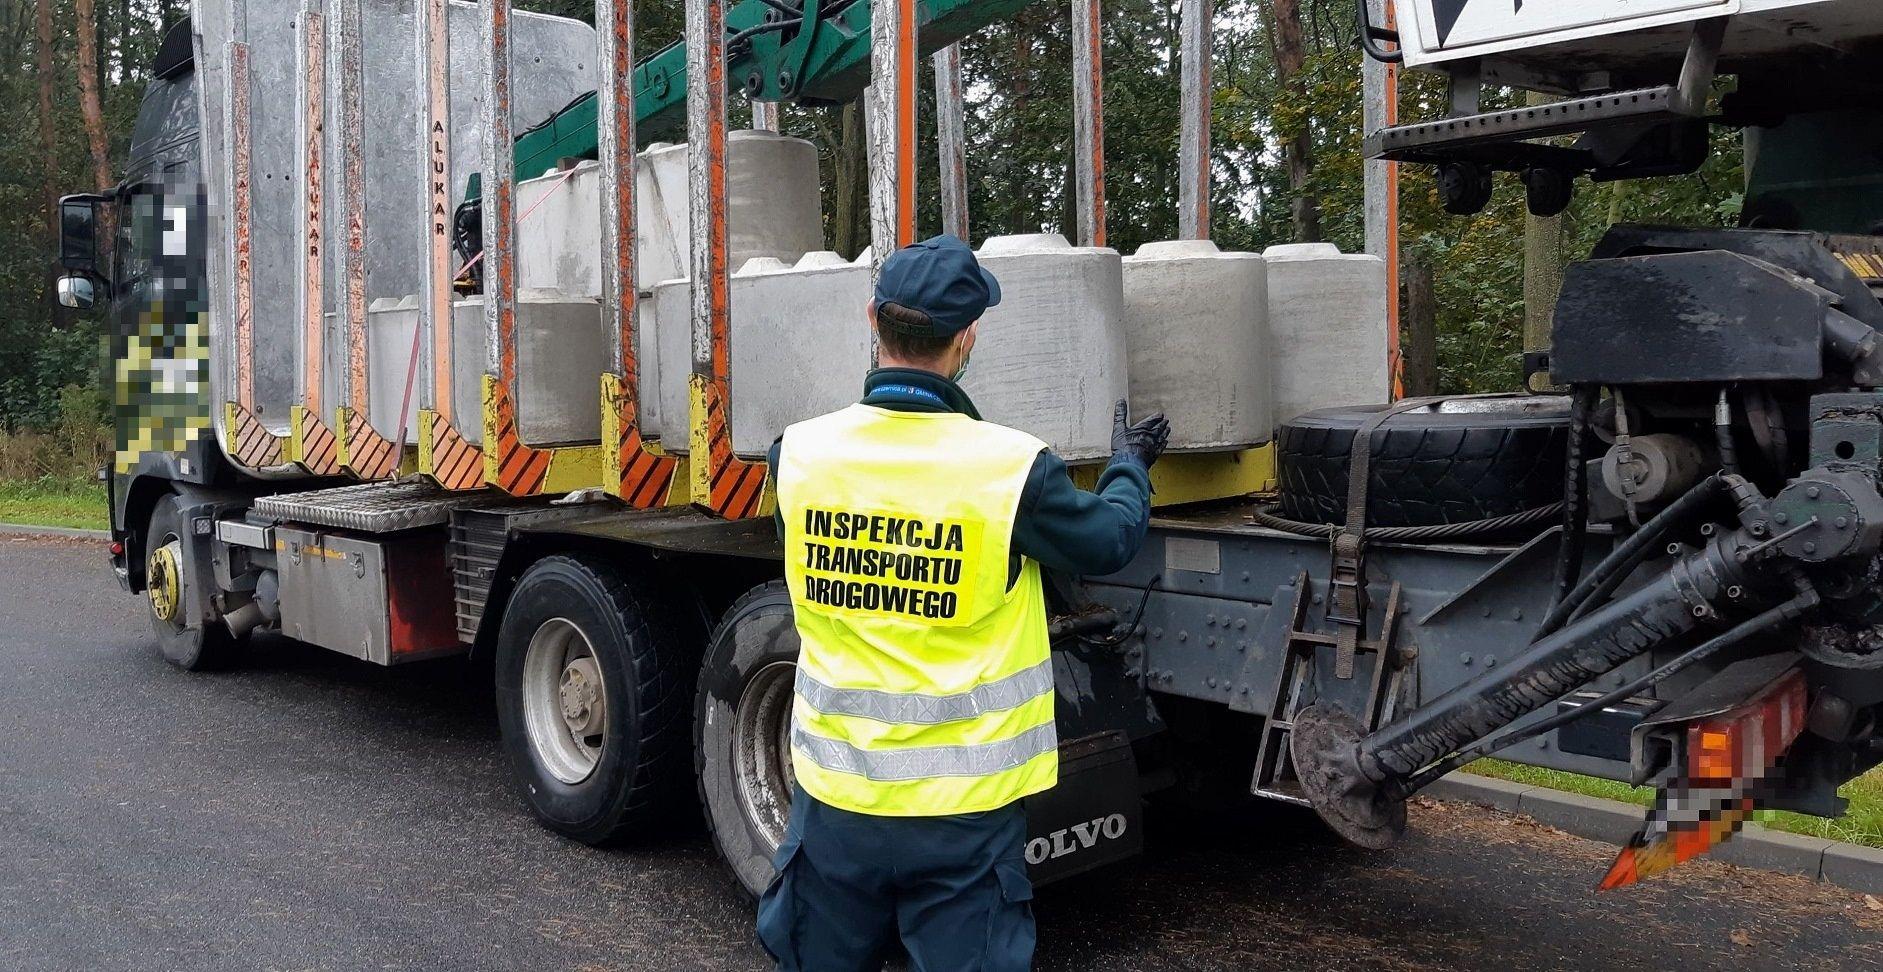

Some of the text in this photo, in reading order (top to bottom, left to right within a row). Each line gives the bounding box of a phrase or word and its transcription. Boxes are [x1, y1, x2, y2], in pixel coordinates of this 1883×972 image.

[433, 120, 445, 236] ALUKAR
[805, 509, 963, 552] INSPEKCJA
[804, 542, 962, 585] TRANSPORTU
[805, 575, 957, 618] DROGOWEGO
[1024, 813, 1127, 865] OLVO
